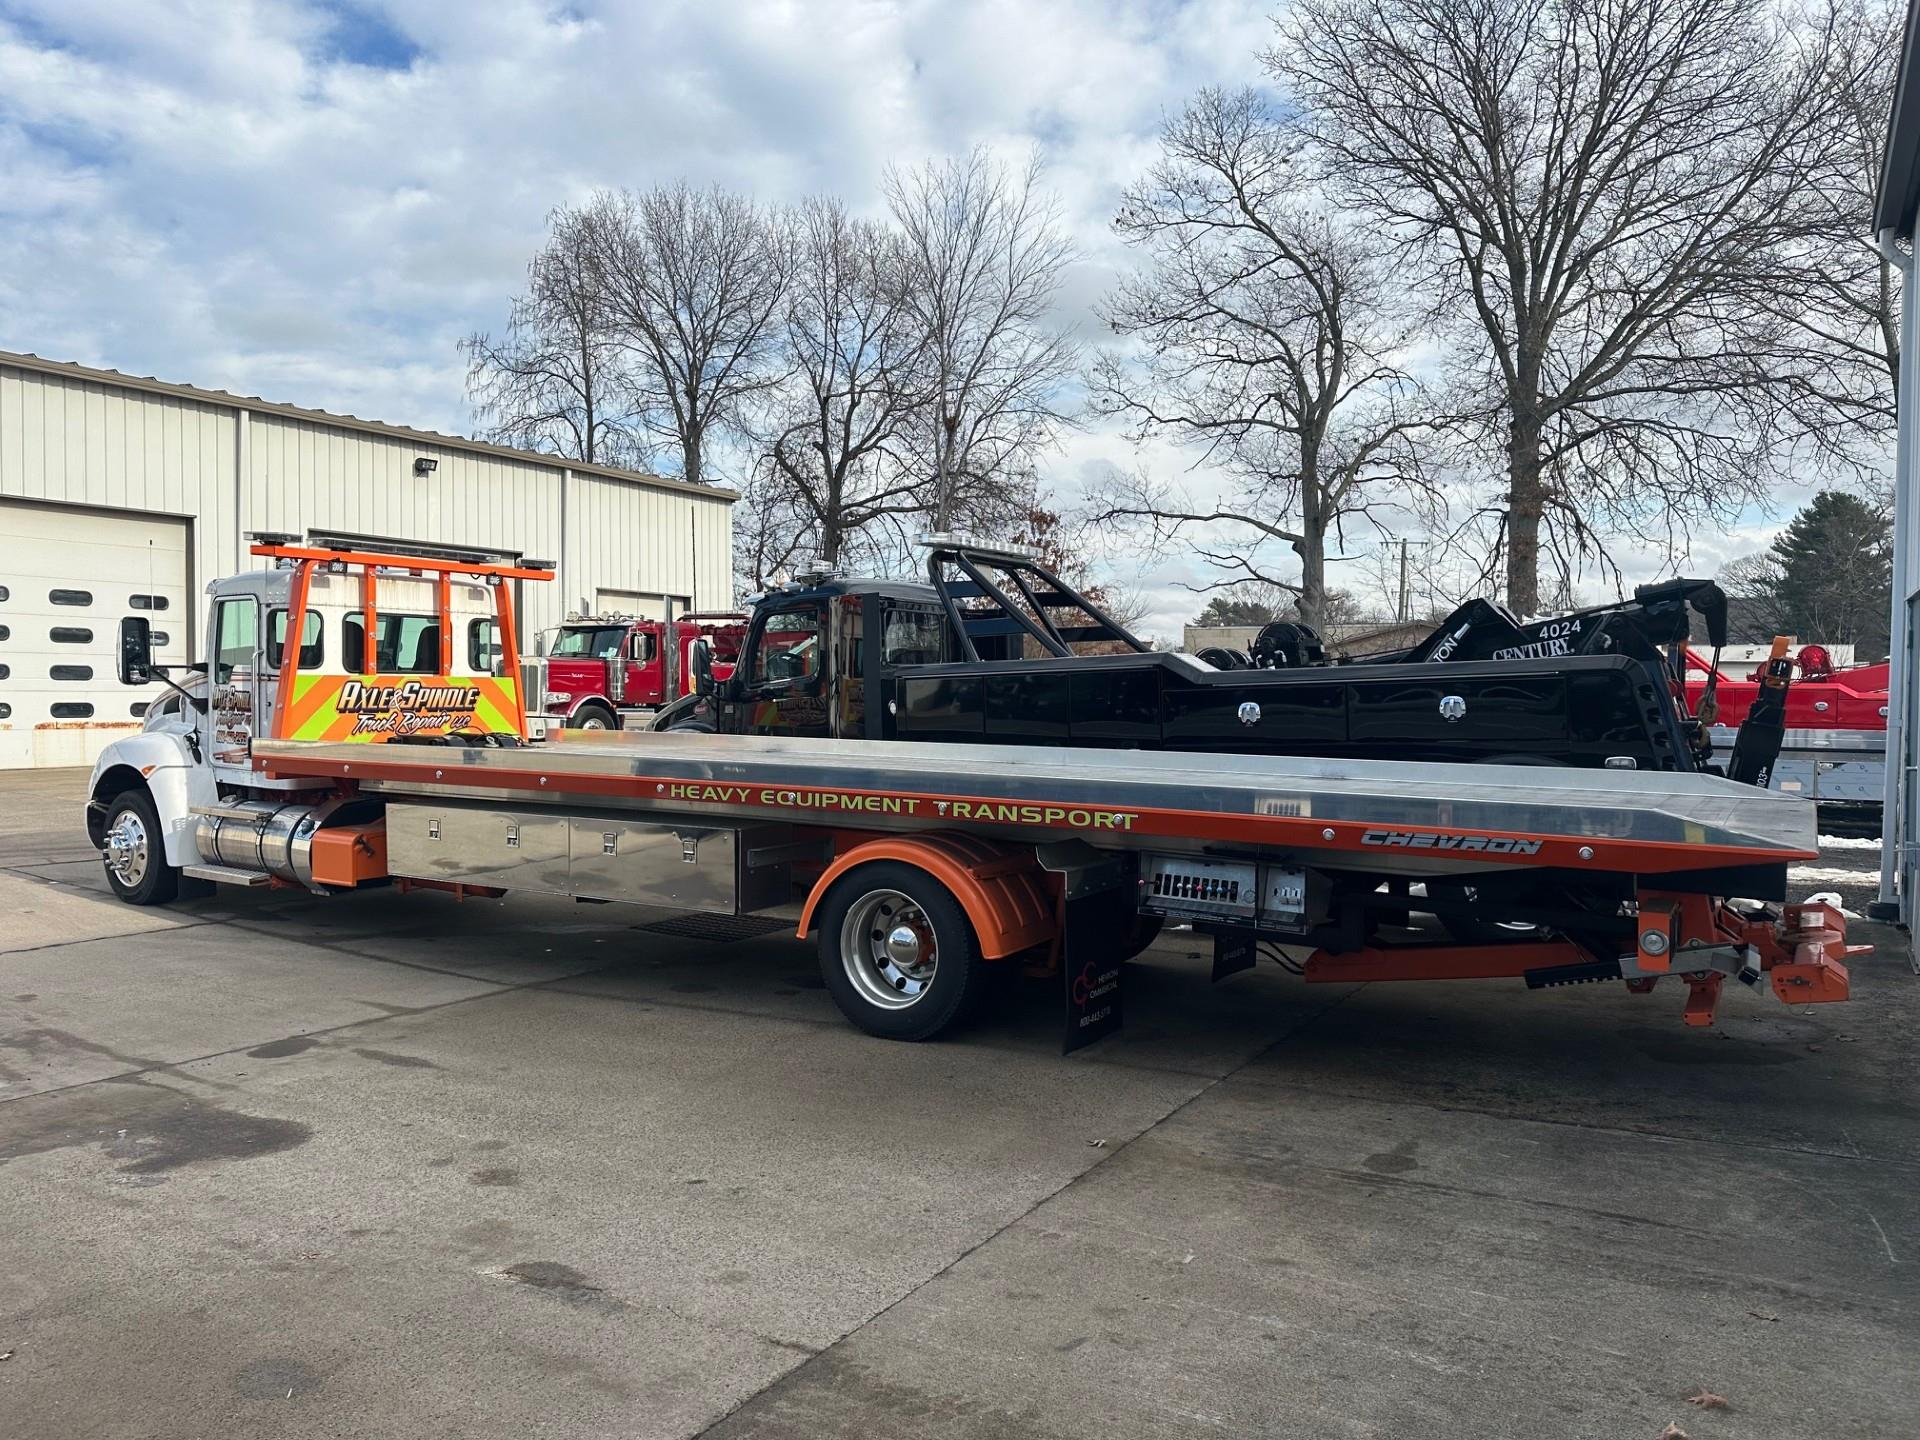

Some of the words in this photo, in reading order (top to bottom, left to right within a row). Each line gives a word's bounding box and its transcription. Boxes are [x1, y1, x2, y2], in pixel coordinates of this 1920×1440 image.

[1539, 620, 1581, 638] 4024
[1433, 637, 1458, 662] TON
[1493, 637, 1569, 660] CENTURY
[352, 713, 397, 735] Truck
[395, 709, 451, 735] Repair
[670, 783, 751, 802] HEAVY
[760, 789, 920, 814] EQUIPMENT
[932, 800, 1139, 830] TRANSPORT
[1360, 829, 1544, 855] CHEVRON
